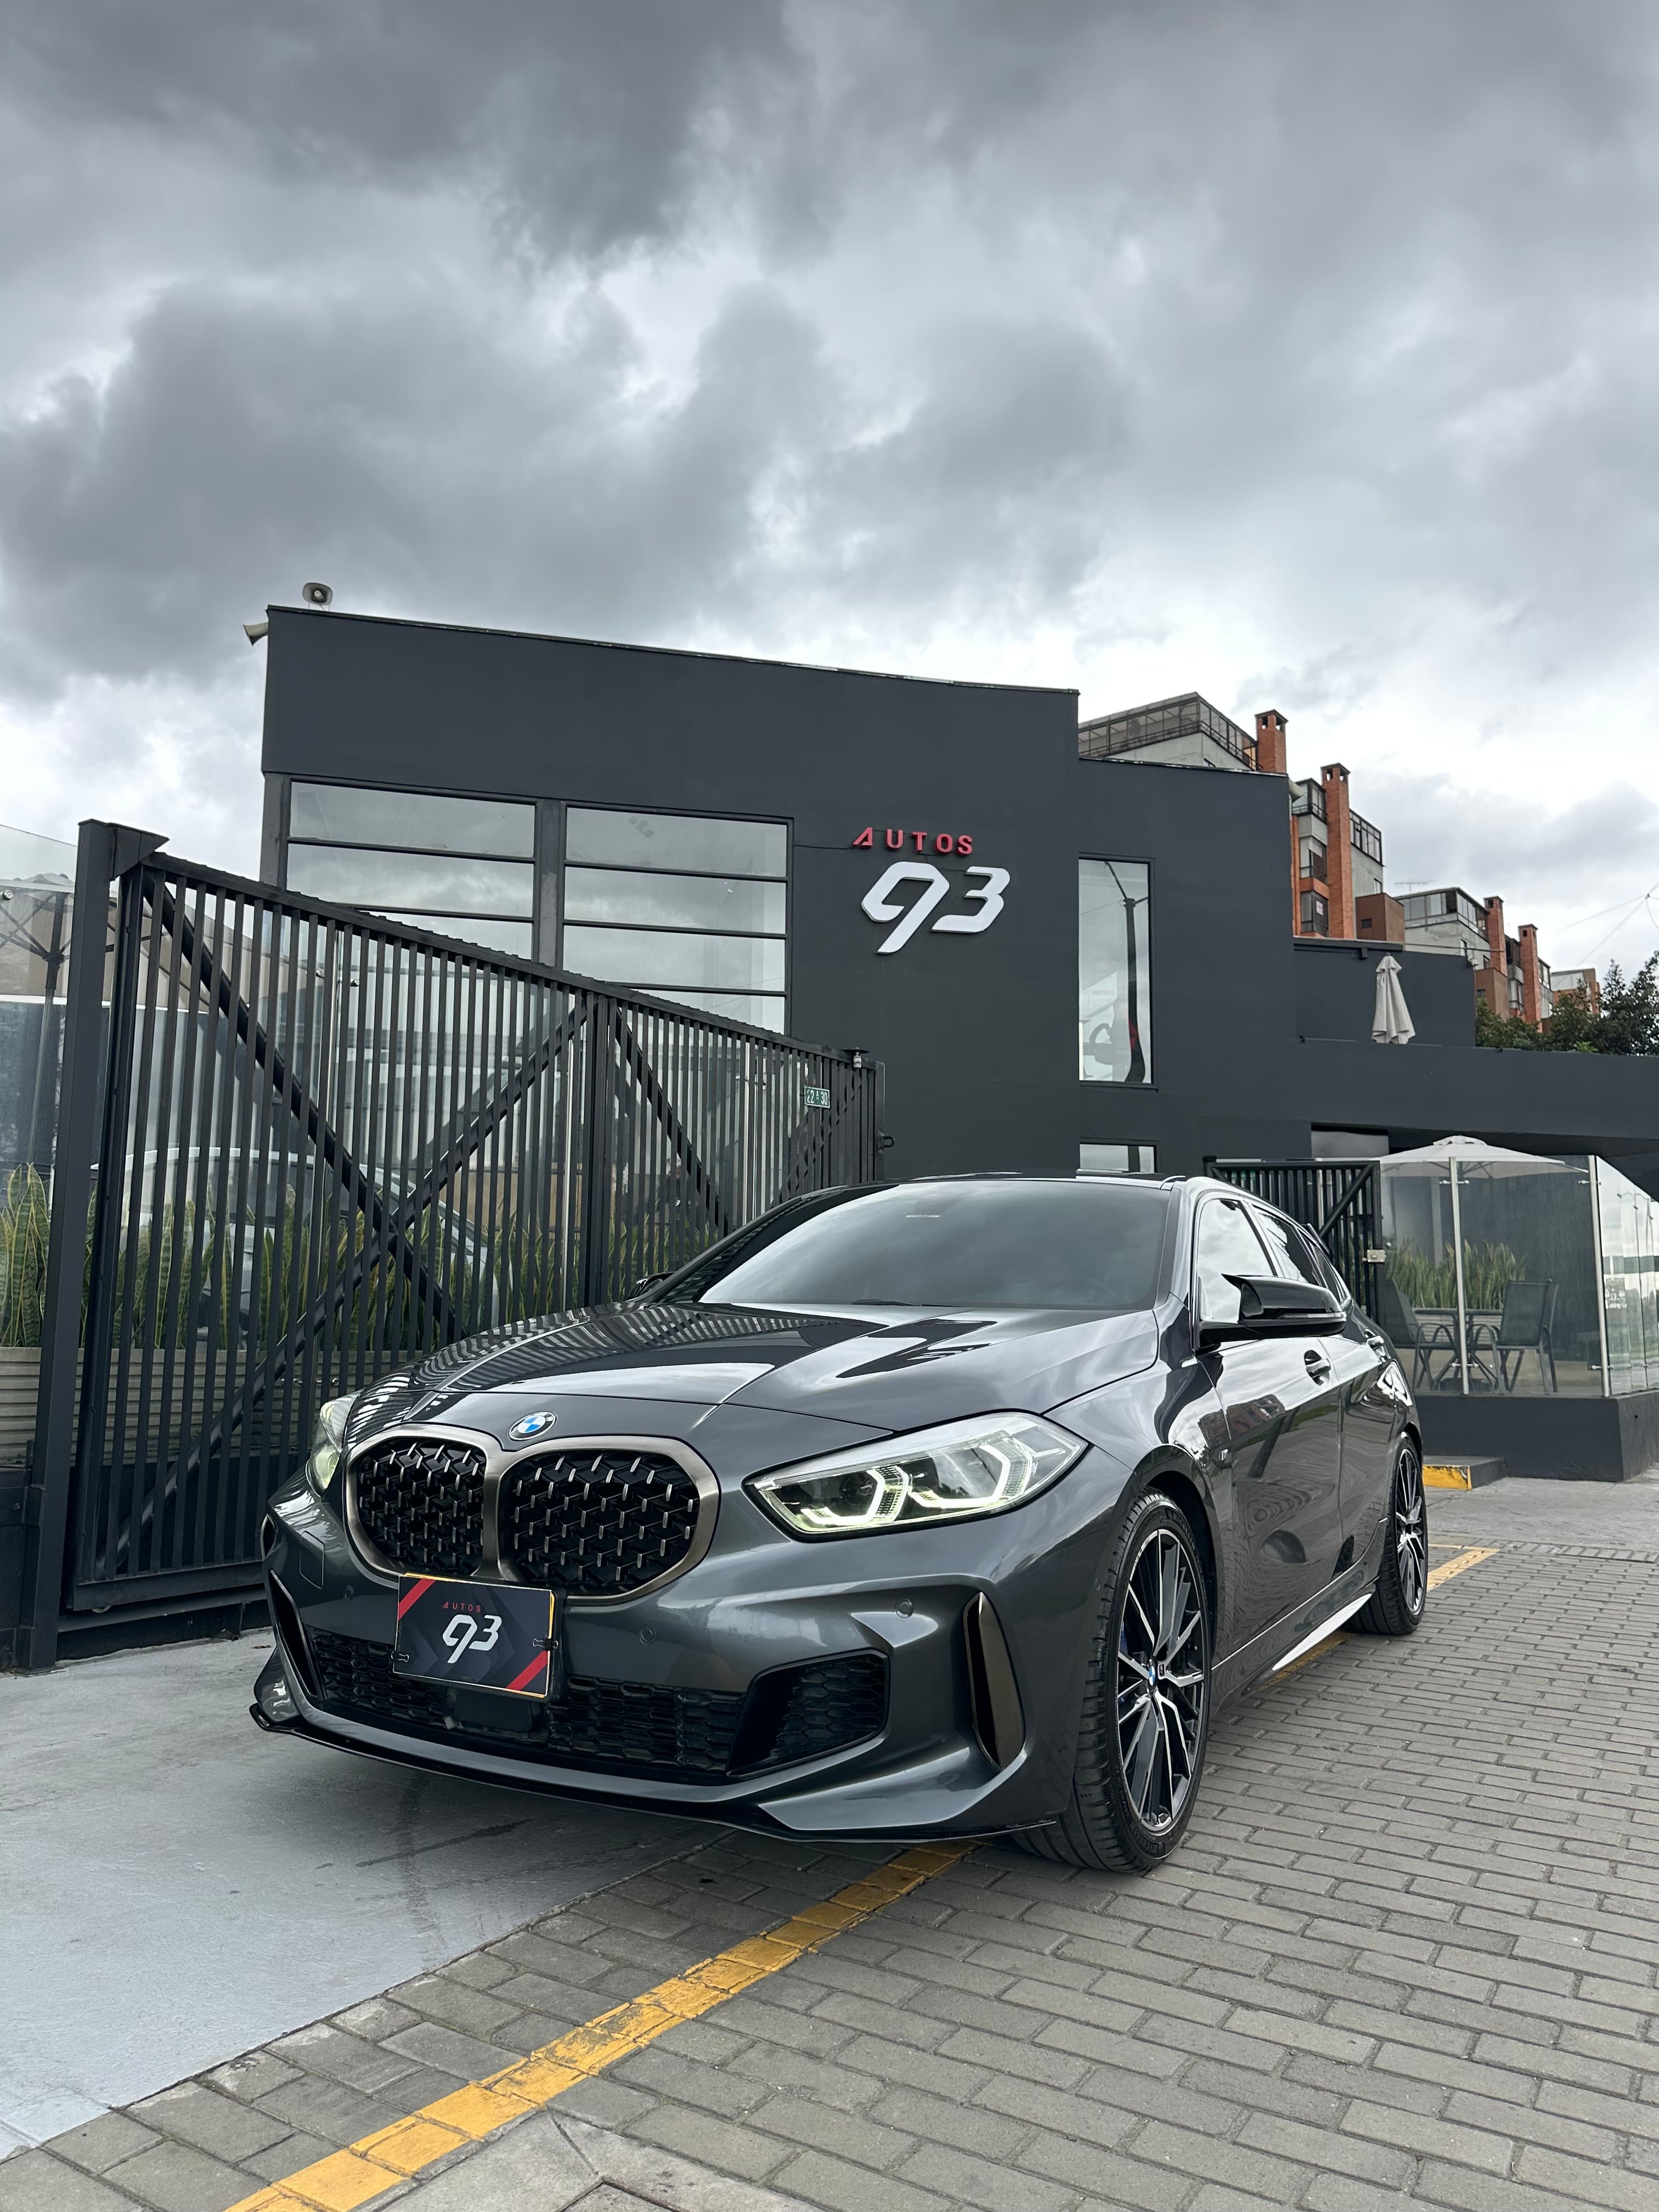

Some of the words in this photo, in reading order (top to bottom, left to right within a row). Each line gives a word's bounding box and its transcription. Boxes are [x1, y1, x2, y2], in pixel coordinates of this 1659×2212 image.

[853, 827, 973, 855] AUTOS
[861, 861, 1011, 955] 93
[820, 1091, 828, 1105] 30
[442, 1601, 482, 1613] AUTOS
[442, 1613, 502, 1664] 93
